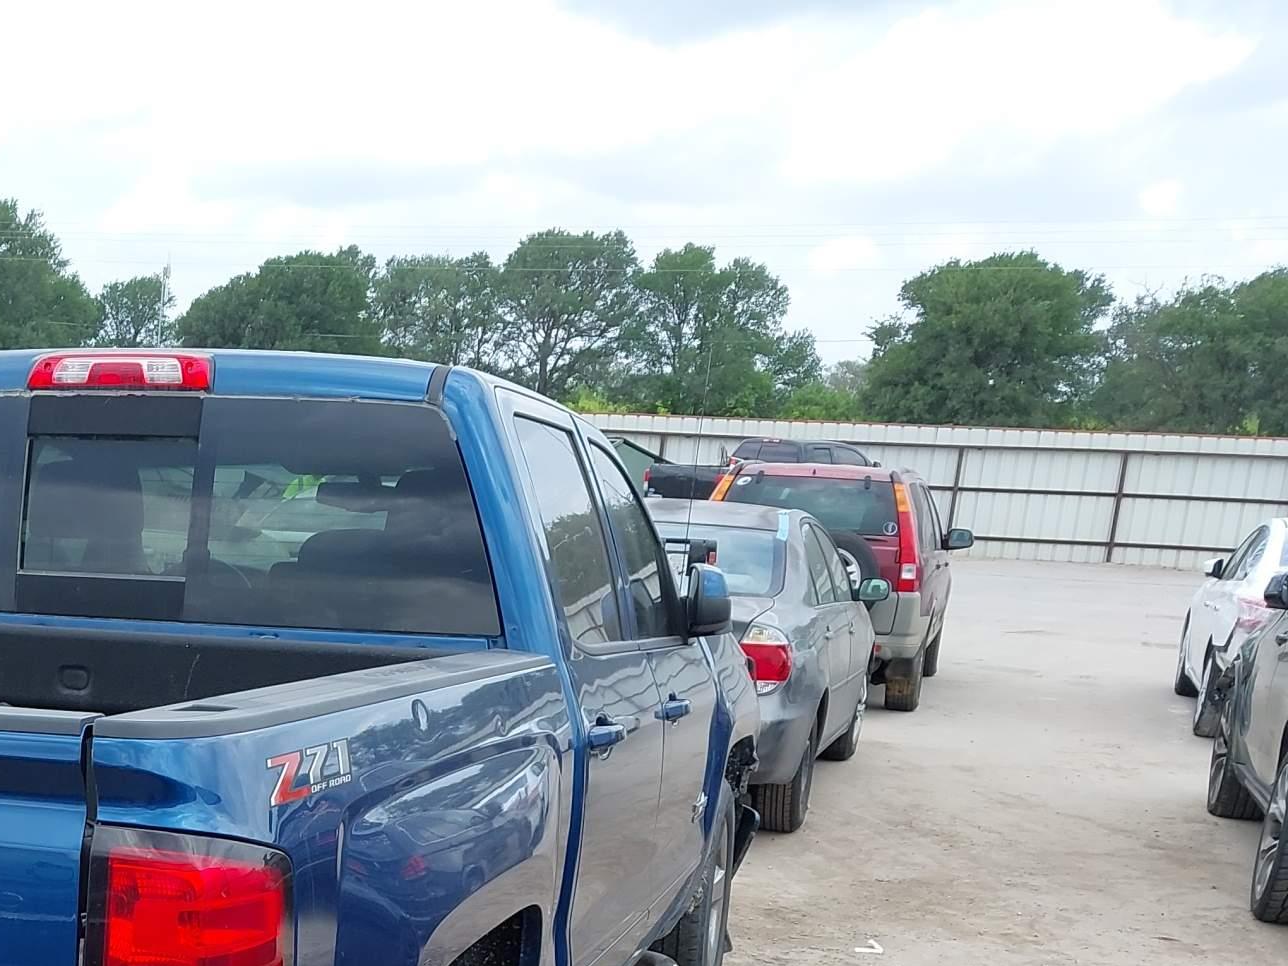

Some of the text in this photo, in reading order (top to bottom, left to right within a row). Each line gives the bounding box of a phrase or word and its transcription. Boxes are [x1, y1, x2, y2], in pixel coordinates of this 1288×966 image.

[266, 738, 352, 808] Z71
[311, 774, 352, 794] OFF ROAD
